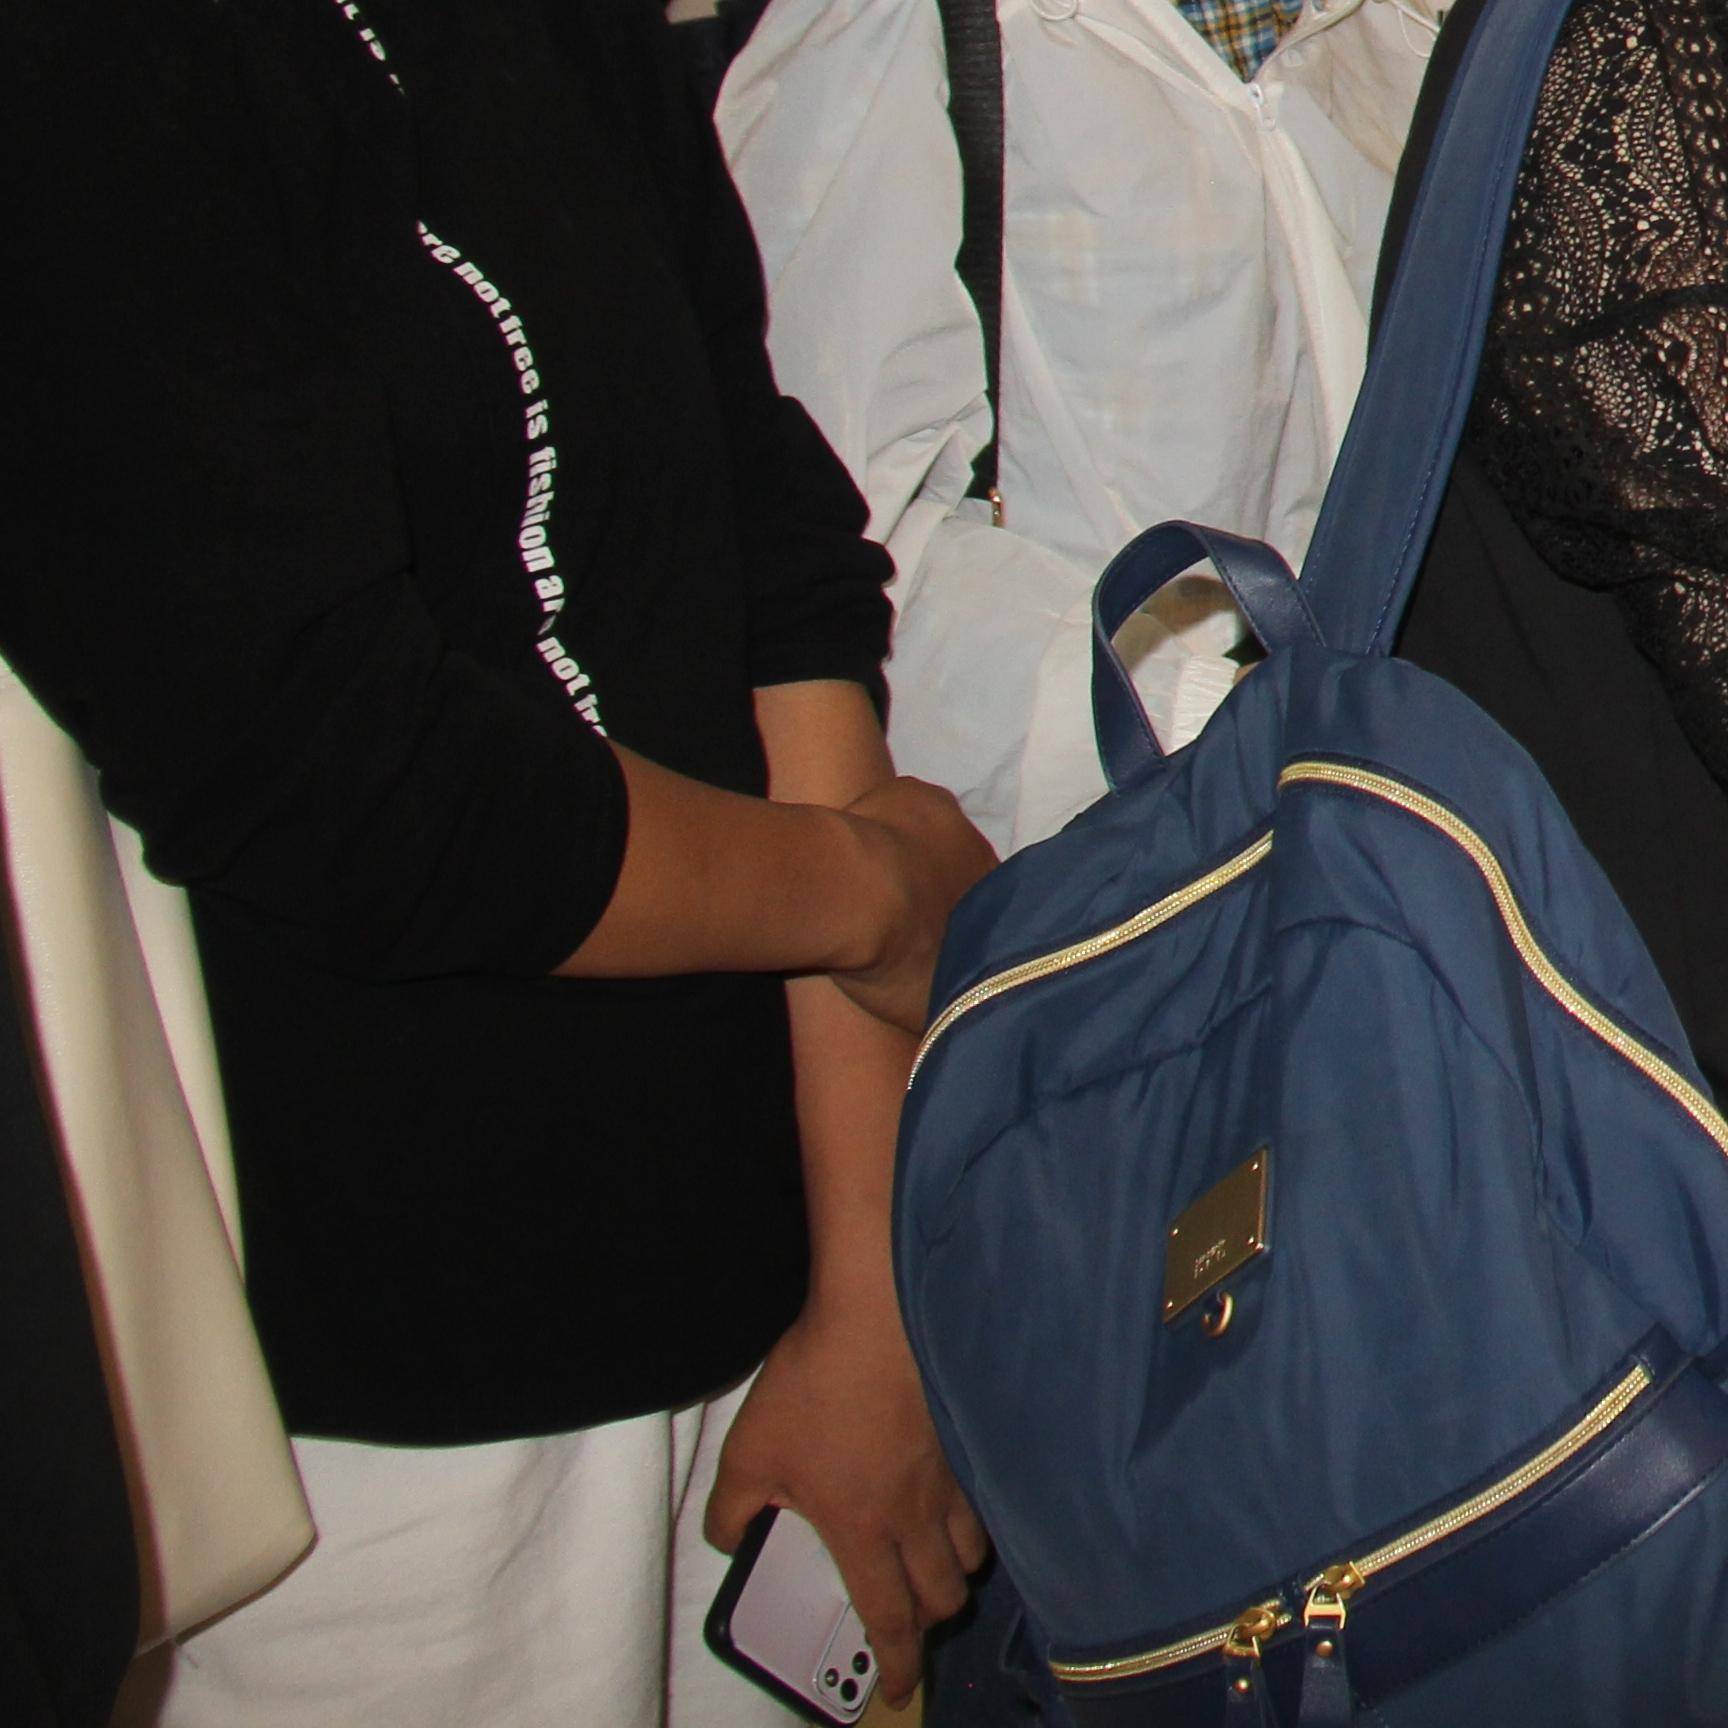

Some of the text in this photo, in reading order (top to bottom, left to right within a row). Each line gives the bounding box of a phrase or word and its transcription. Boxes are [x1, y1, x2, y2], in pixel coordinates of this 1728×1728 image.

[453, 261, 512, 319] not
[499, 315, 541, 394] free
[525, 399, 549, 440] is
[518, 446, 558, 573] fishion
[536, 636, 591, 697] not
